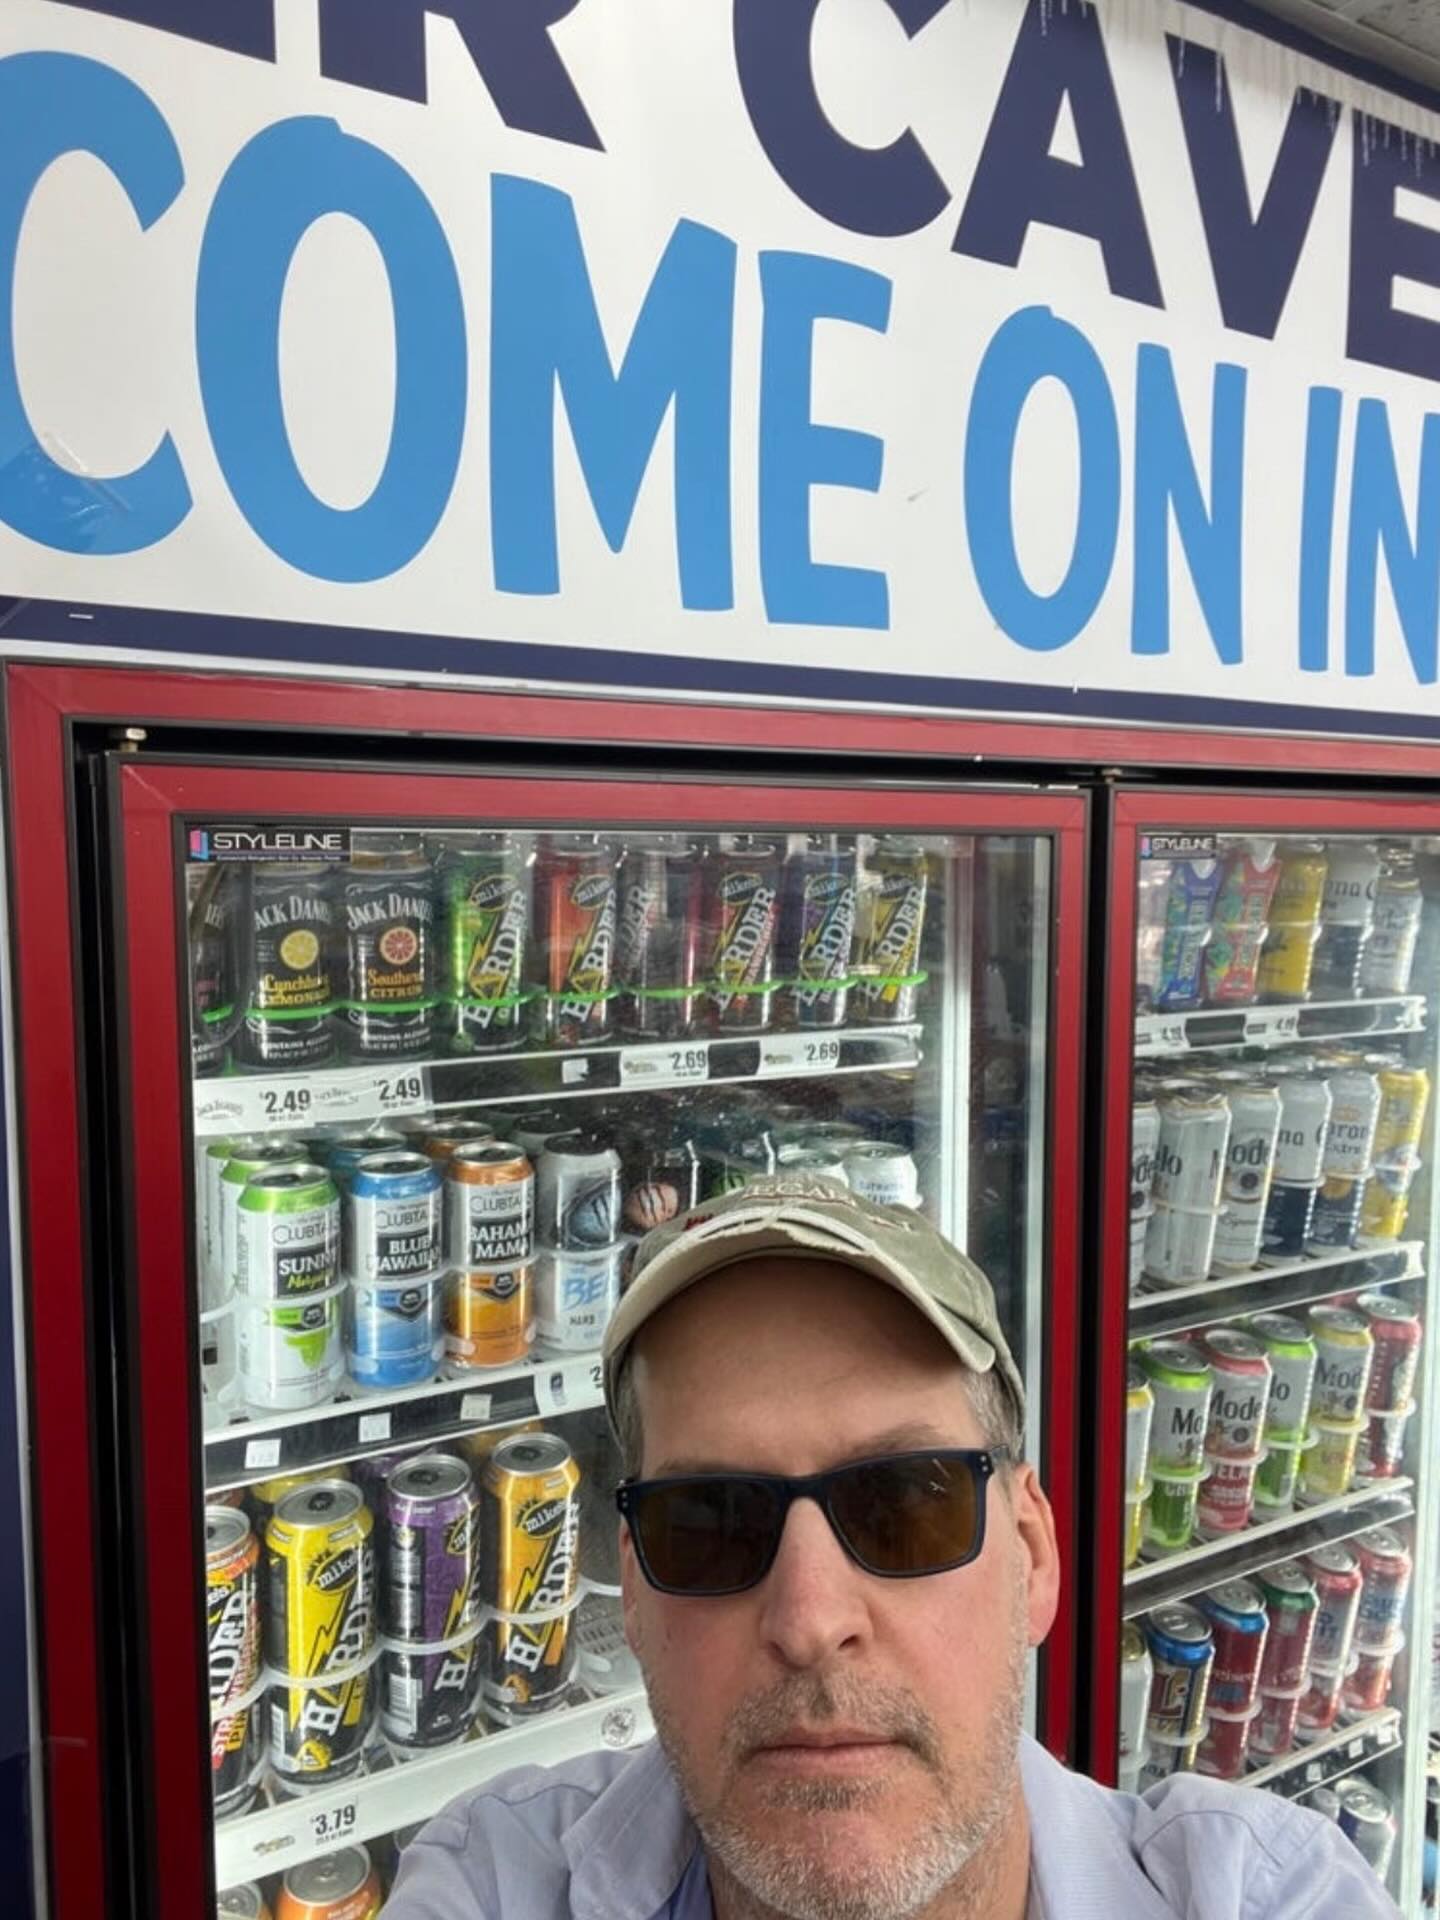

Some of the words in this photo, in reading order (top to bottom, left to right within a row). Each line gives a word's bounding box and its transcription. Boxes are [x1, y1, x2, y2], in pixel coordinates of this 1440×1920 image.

[0, 50, 893, 632] COME
[963, 304, 1248, 666] ON
[1298, 385, 1440, 686] IN
[213, 833, 342, 850] STYLELINE
[254, 904, 288, 931] ACK
[347, 901, 388, 930] JACK
